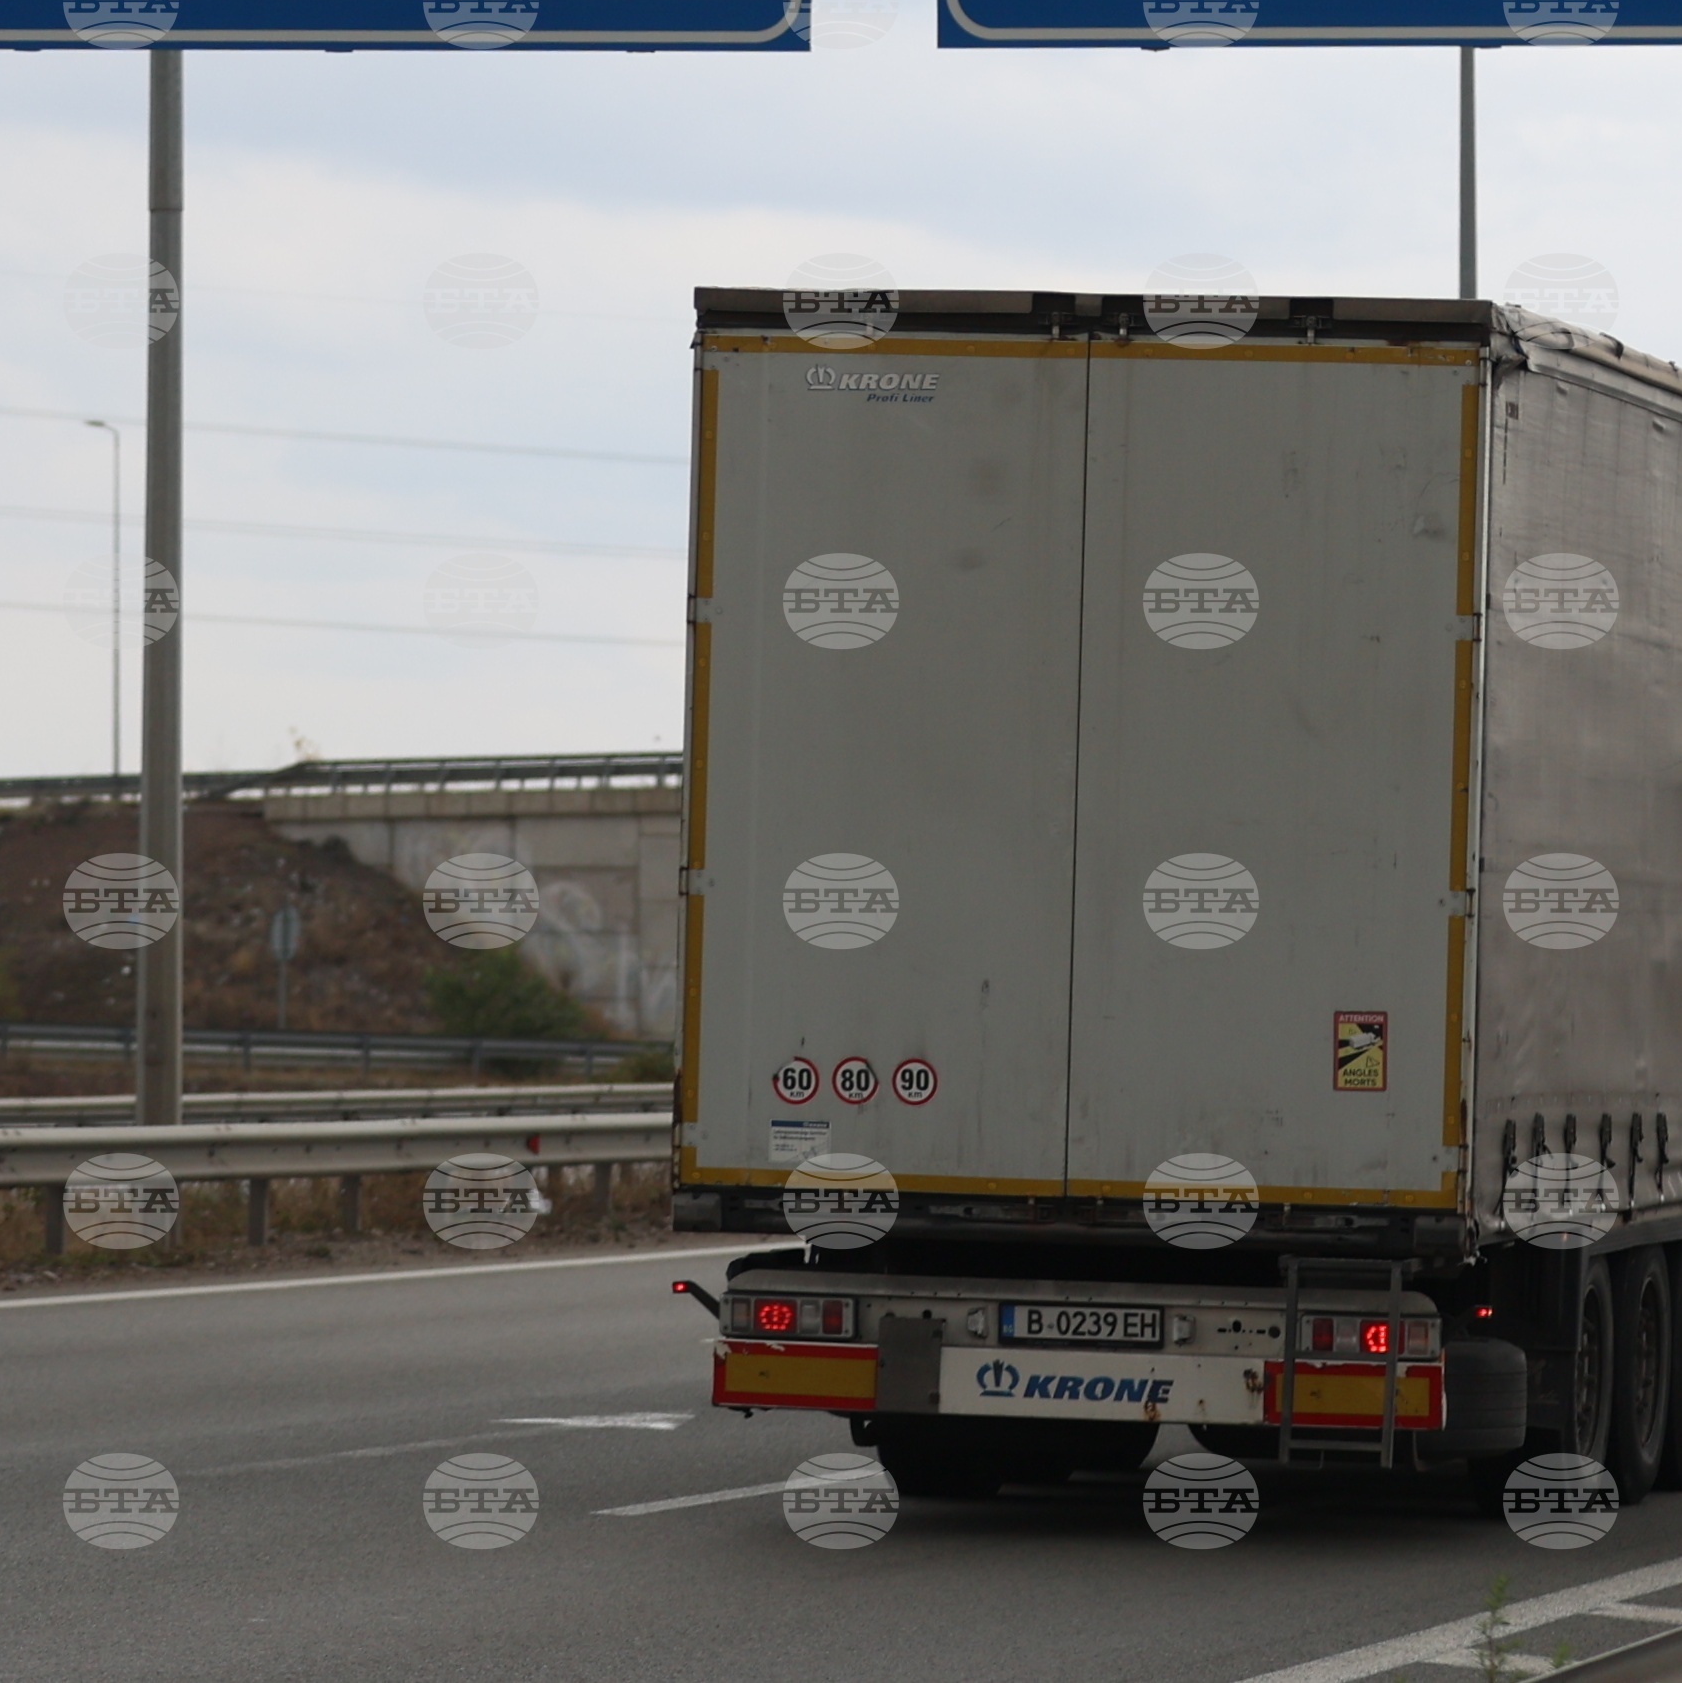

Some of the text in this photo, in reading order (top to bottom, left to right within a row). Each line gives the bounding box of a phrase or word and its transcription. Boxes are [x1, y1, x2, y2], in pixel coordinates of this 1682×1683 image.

[838, 373, 940, 391] KRONE
[1339, 1014, 1384, 1022] ATTENTION
[783, 1068, 812, 1090] 60
[841, 1069, 870, 1092] 80
[901, 1069, 930, 1091] 90
[1343, 1068, 1379, 1077] ANGLES
[1344, 1078, 1377, 1086] MORTS
[1056, 1310, 1118, 1337] 0239
[1123, 1312, 1157, 1338] EH
[1023, 1374, 1174, 1404] KRONE
